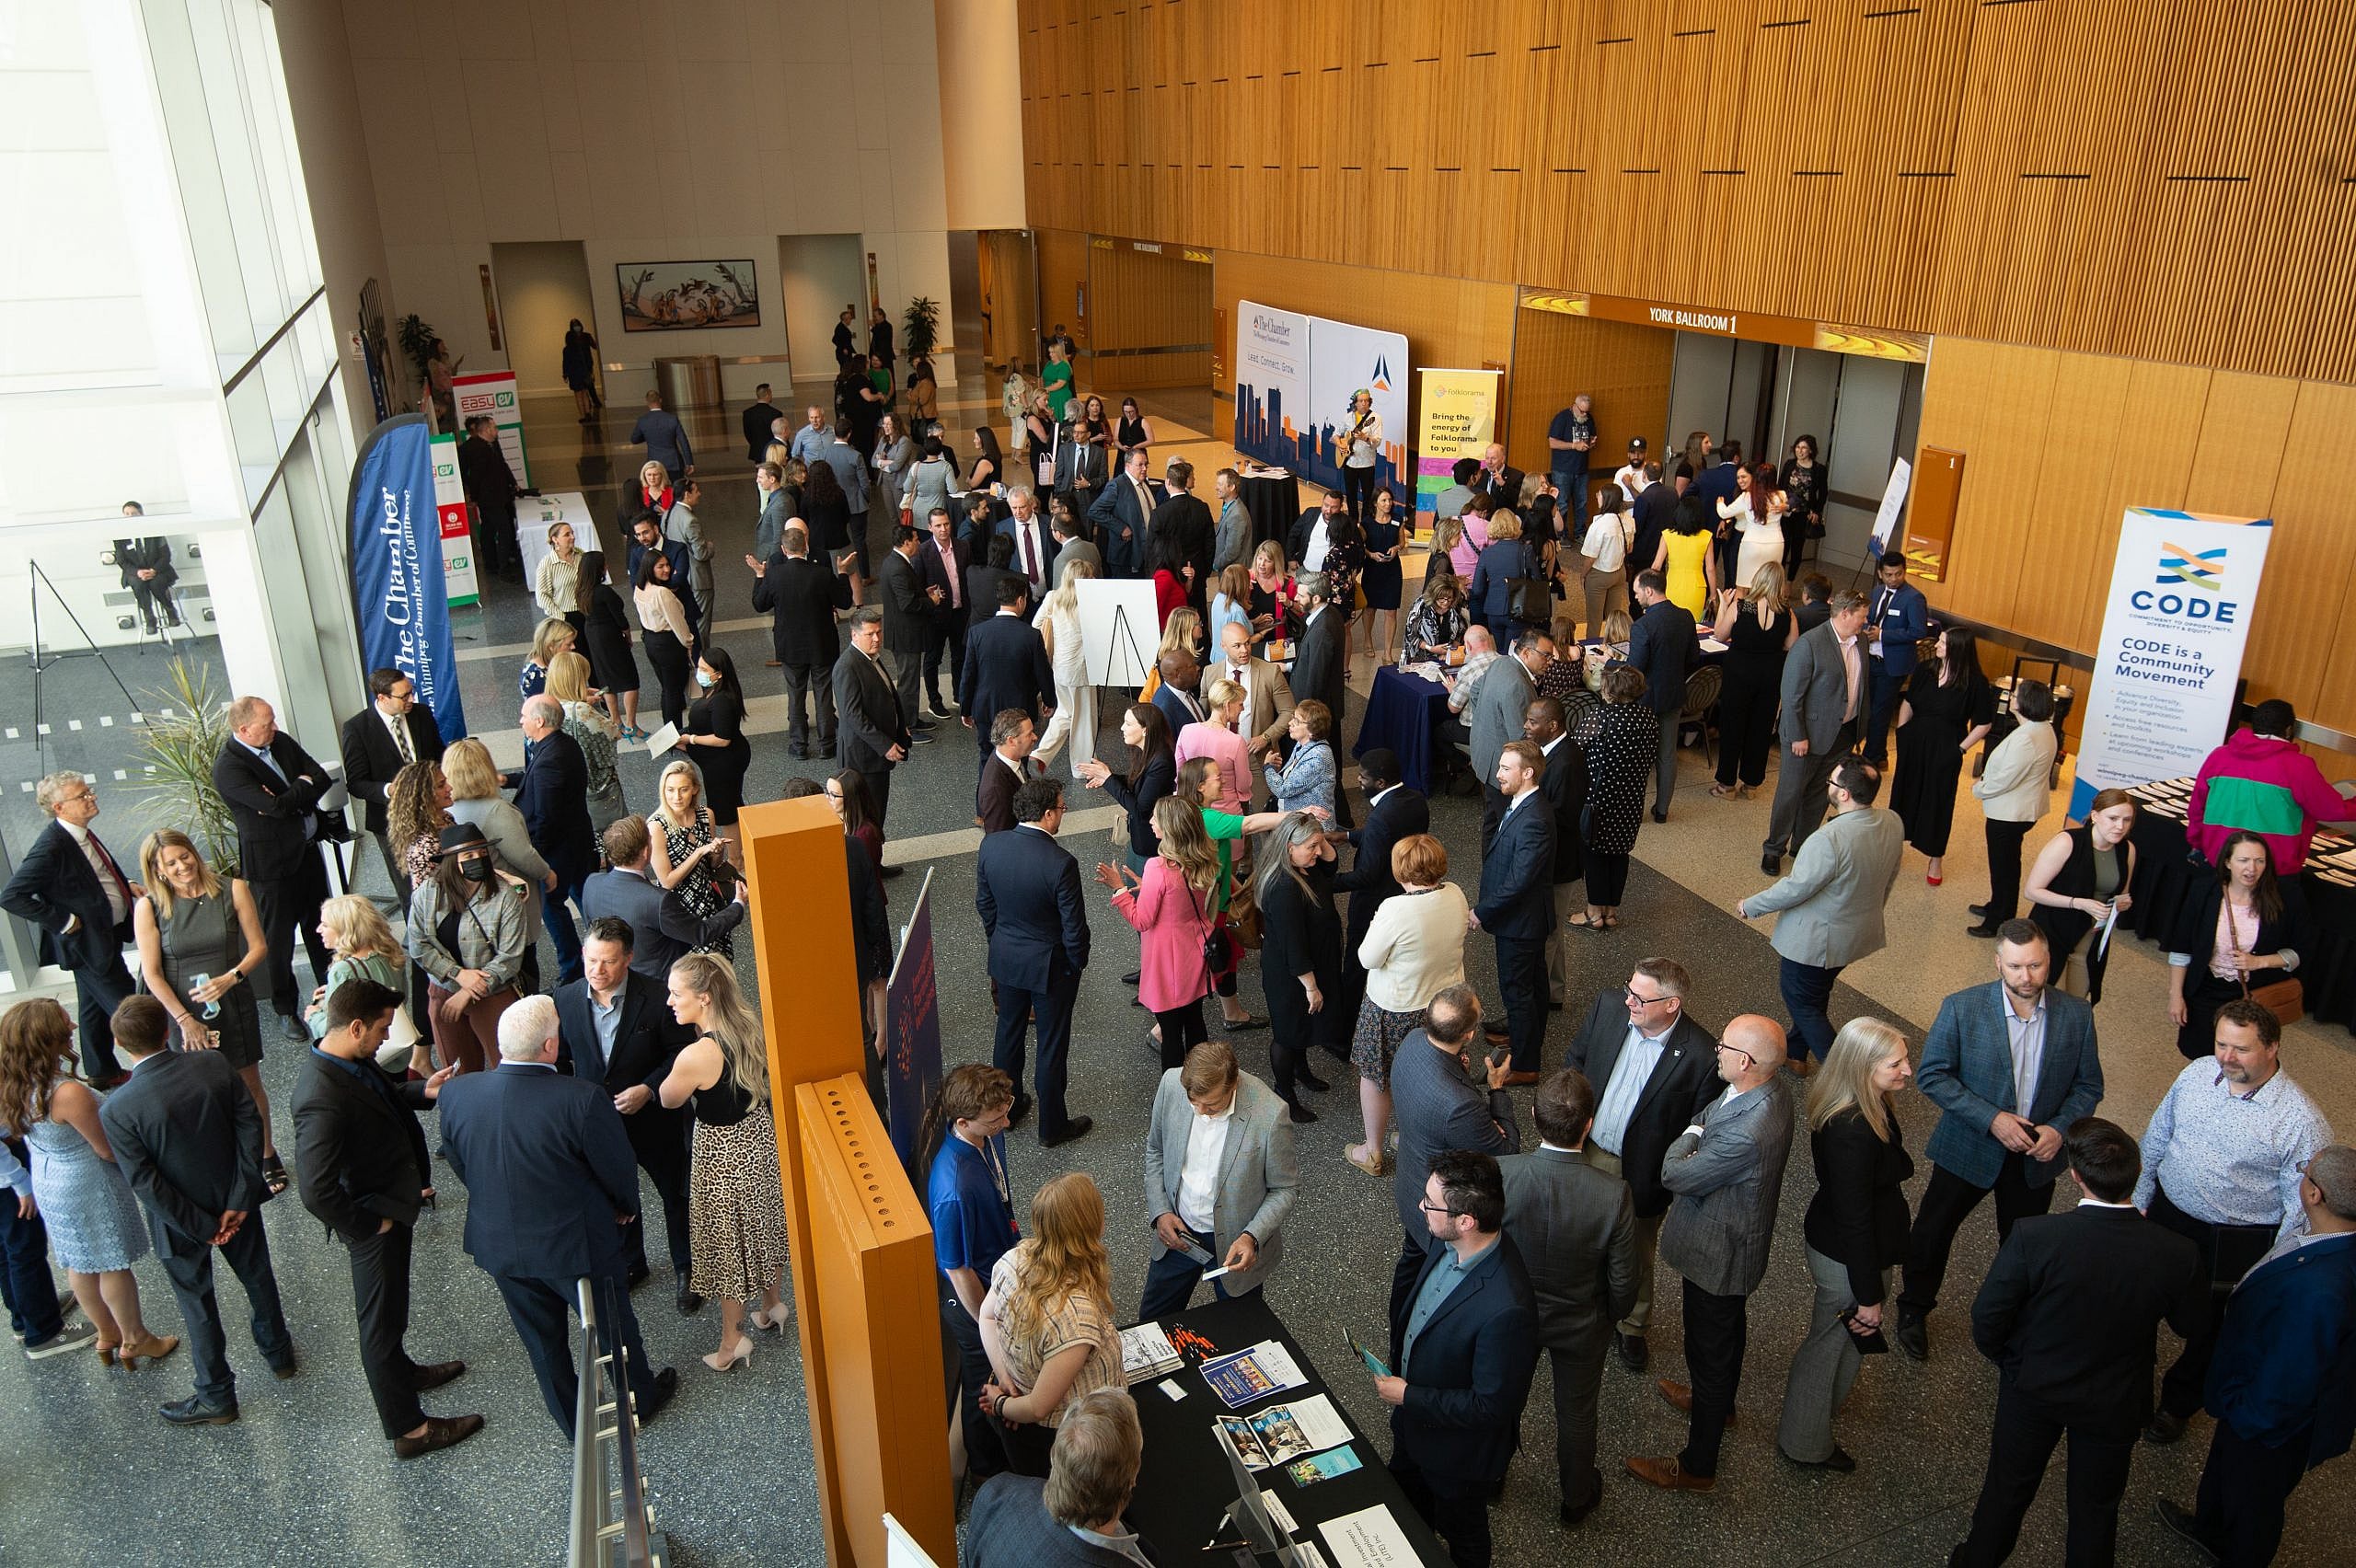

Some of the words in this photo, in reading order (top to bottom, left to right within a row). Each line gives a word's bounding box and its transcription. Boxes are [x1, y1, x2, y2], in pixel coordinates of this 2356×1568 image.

[1258, 315, 1268, 331] The
[1268, 317, 1290, 337] Chamber
[1649, 306, 1674, 324] YORK
[1675, 310, 1728, 331] BALLROOM
[1729, 315, 1737, 334] 1
[498, 393, 513, 406] ev
[1448, 388, 1485, 397] folklorama
[1432, 412, 1455, 421] Bring
[1431, 424, 1461, 432] energy
[1431, 433, 1478, 443] Folklorama
[1949, 456, 1955, 469] 1
[380, 486, 411, 626] Chamber
[453, 558, 468, 569] ev
[405, 560, 420, 575] of
[410, 575, 423, 637] Chamber
[2131, 590, 2237, 624] CODE
[2129, 613, 2172, 624] COMMITMENT
[2146, 621, 2180, 630] DIVERSITY
[2188, 627, 2212, 635] EQUITY
[2121, 638, 2172, 655] CODE
[2175, 645, 2189, 658] is
[2192, 651, 2202, 660] a
[417, 638, 434, 697] Winnipeg
[2119, 651, 2215, 679] Community
[2115, 664, 2206, 690] Movement
[2118, 689, 2148, 700] Advance
[2116, 697, 2138, 707] Equity
[2140, 700, 2154, 709] and
[2112, 713, 2137, 724] Access
[2138, 717, 2153, 726] free
[2154, 721, 2188, 733] resources
[2109, 731, 2130, 740] Learn
[2131, 734, 2147, 744] from
[2149, 738, 2176, 750] leading
[2176, 744, 2204, 755] experts
[2117, 741, 2152, 753] upcoming
[2154, 747, 2192, 760] workshops
[2121, 747, 2165, 761] conferences
